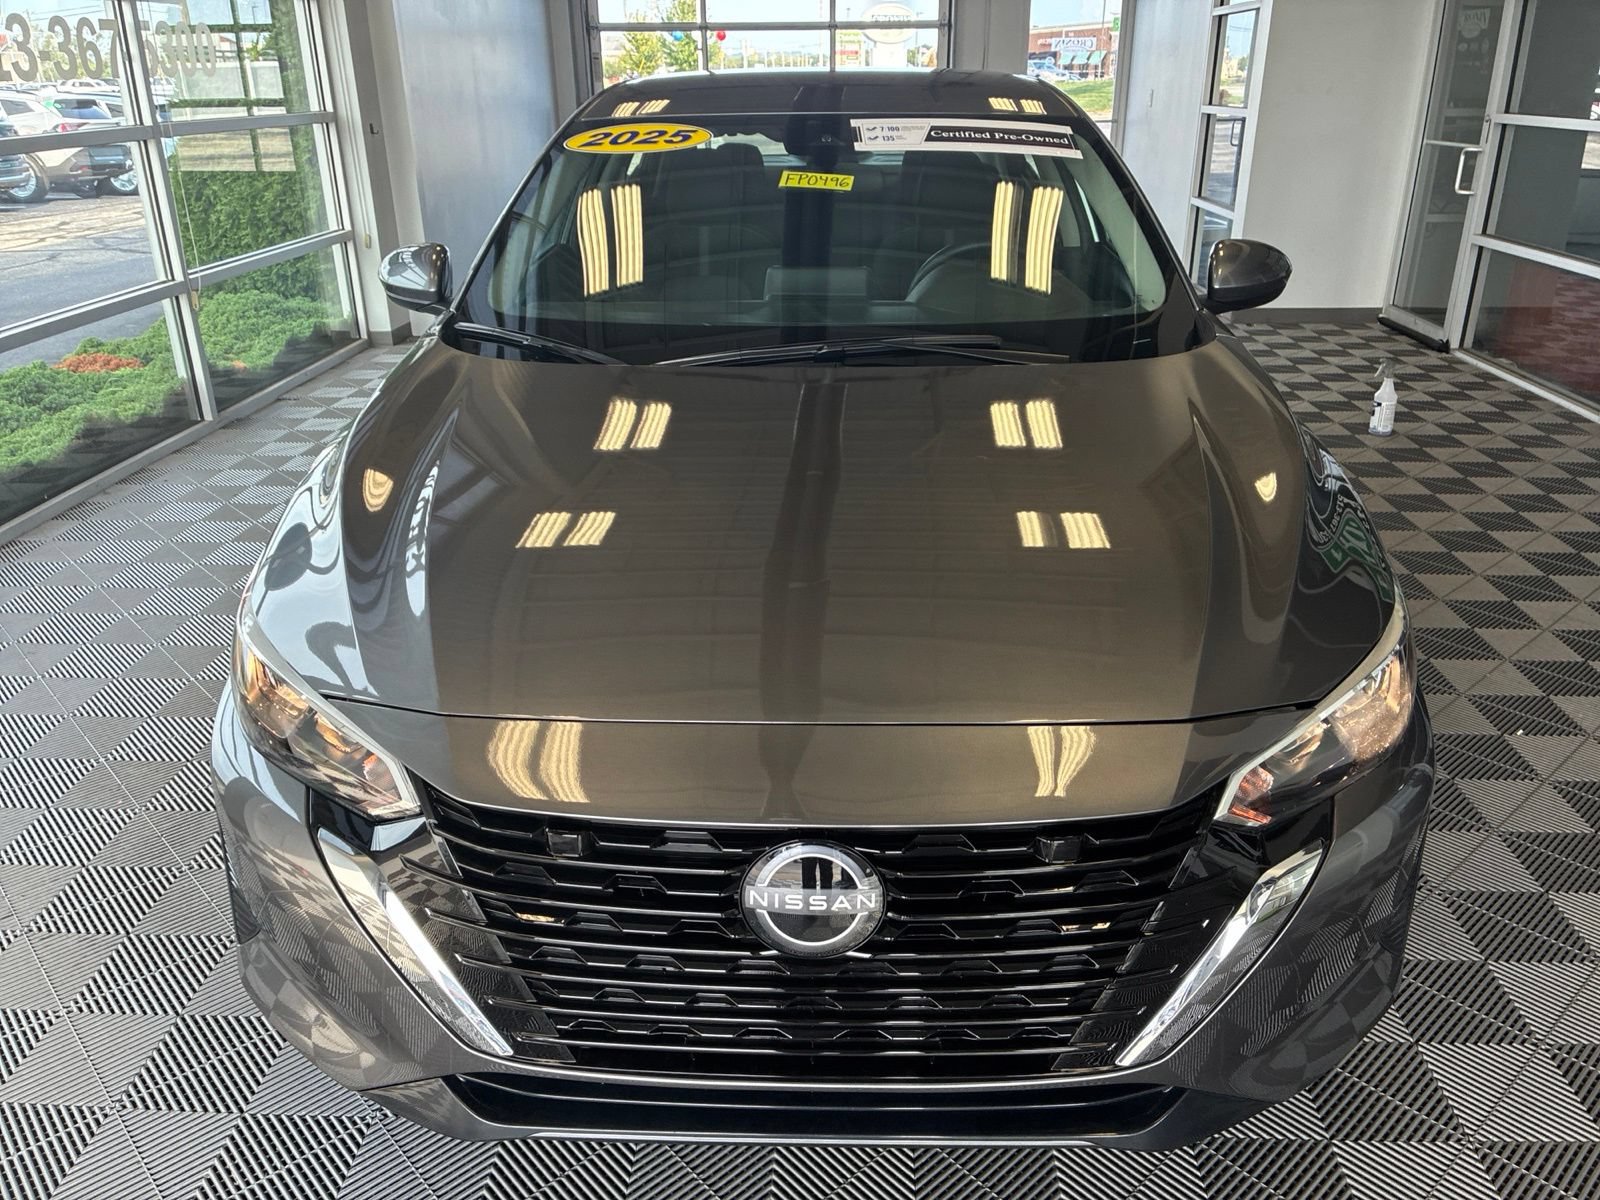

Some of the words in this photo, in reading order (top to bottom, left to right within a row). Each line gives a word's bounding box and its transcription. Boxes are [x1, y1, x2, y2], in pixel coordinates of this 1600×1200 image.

[577, 129, 699, 148] 2025
[930, 129, 991, 139] Certified
[993, 132, 1069, 145] Pre-Owned
[749, 889, 876, 911] NISSAN
